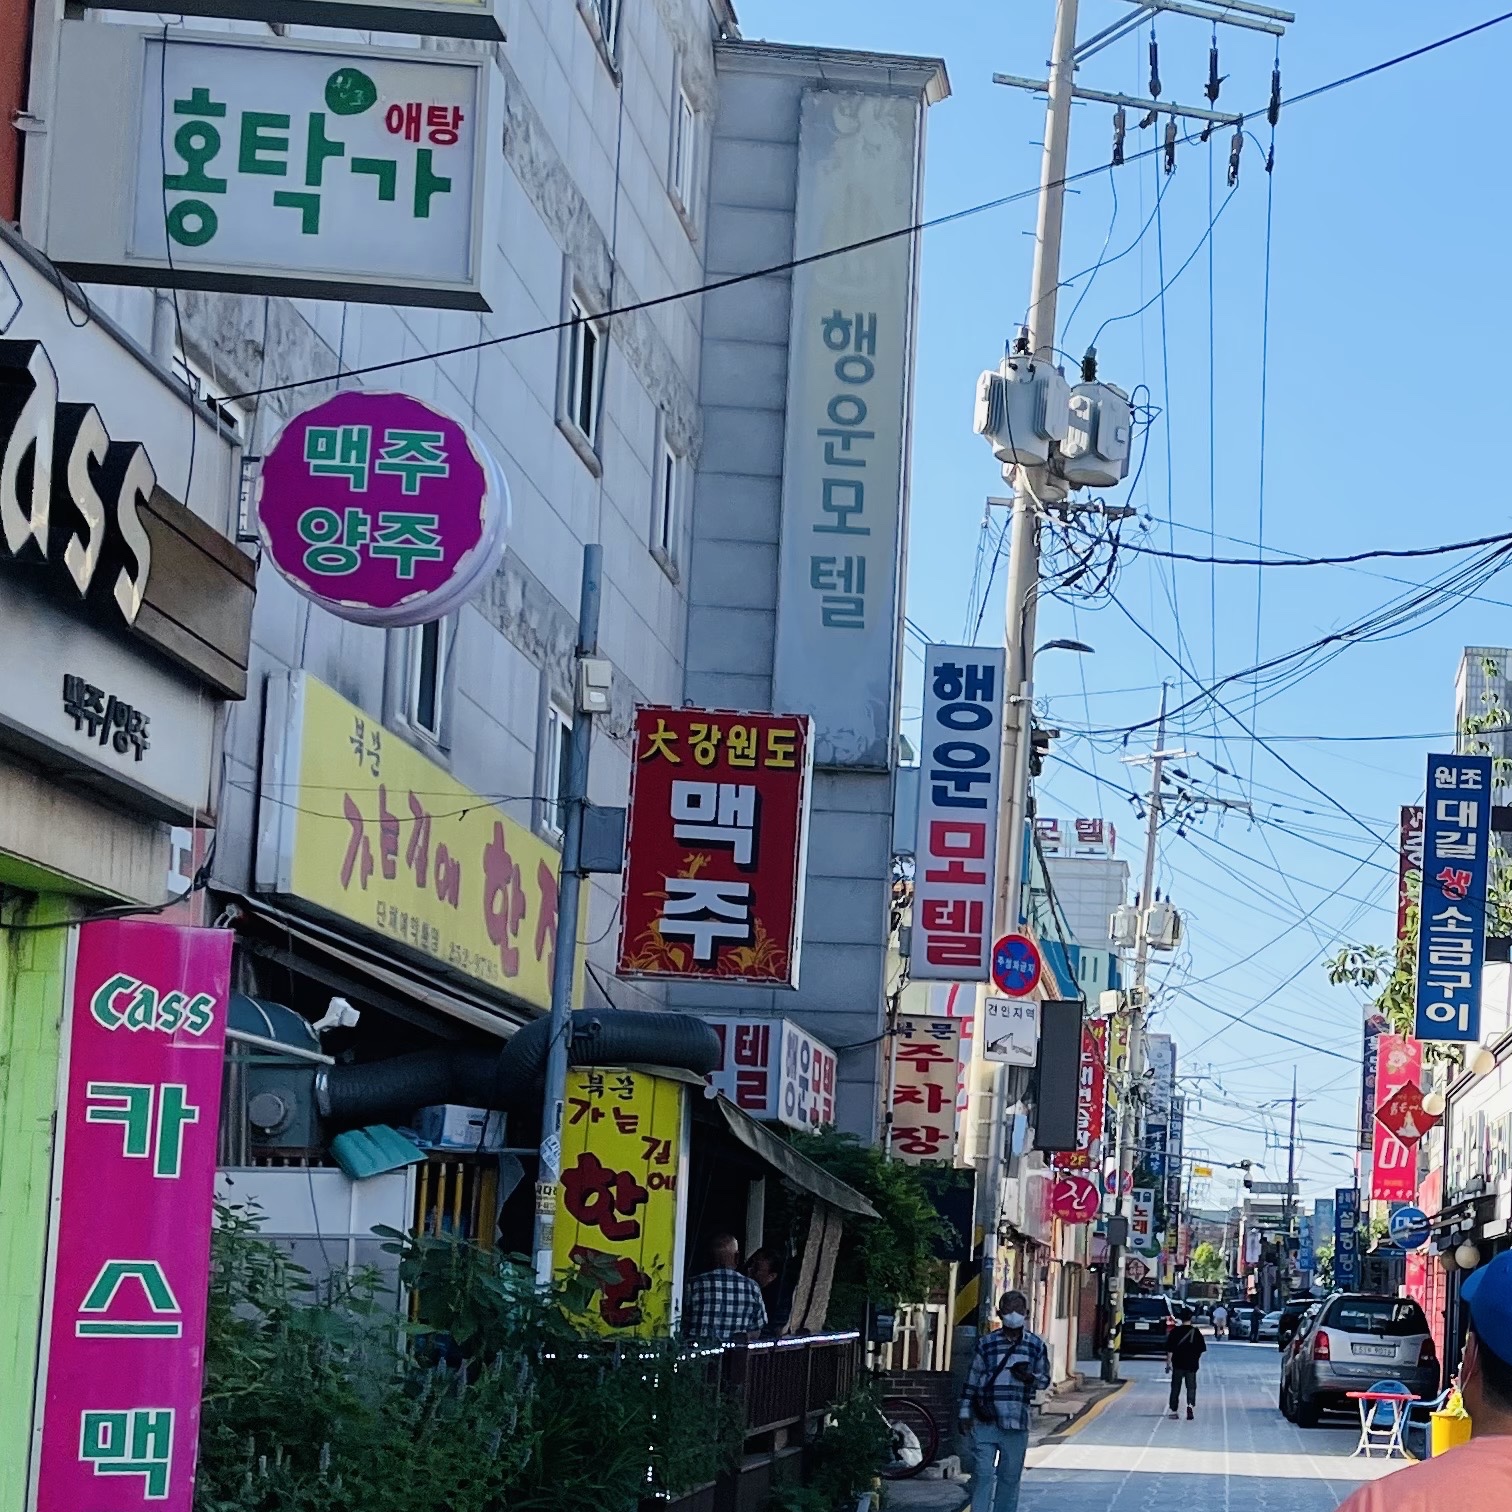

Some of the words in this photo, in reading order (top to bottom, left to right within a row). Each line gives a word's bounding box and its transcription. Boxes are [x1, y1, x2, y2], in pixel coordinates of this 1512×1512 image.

[385, 103, 465, 145] 애탕
[164, 87, 452, 247] 홍탁가
[0, 262, 157, 627] ass
[304, 424, 449, 496] 맥주
[809, 309, 877, 629] 행운모텔
[298, 506, 444, 579] 양주
[63, 673, 151, 762] 맥주/양주
[1435, 766, 1482, 789] 원조
[922, 662, 996, 968] 행운모텔
[1435, 799, 1478, 860] 대길
[657, 780, 757, 963] 맥주
[90, 972, 216, 1036] Cass
[988, 1003, 1035, 1020] 견인지역
[578, 1074, 635, 1101] 북문
[882, 1042, 955, 1155] 주차장
[1070, 1155, 1087, 1166] 2F
[75, 1081, 199, 1338] 카스
